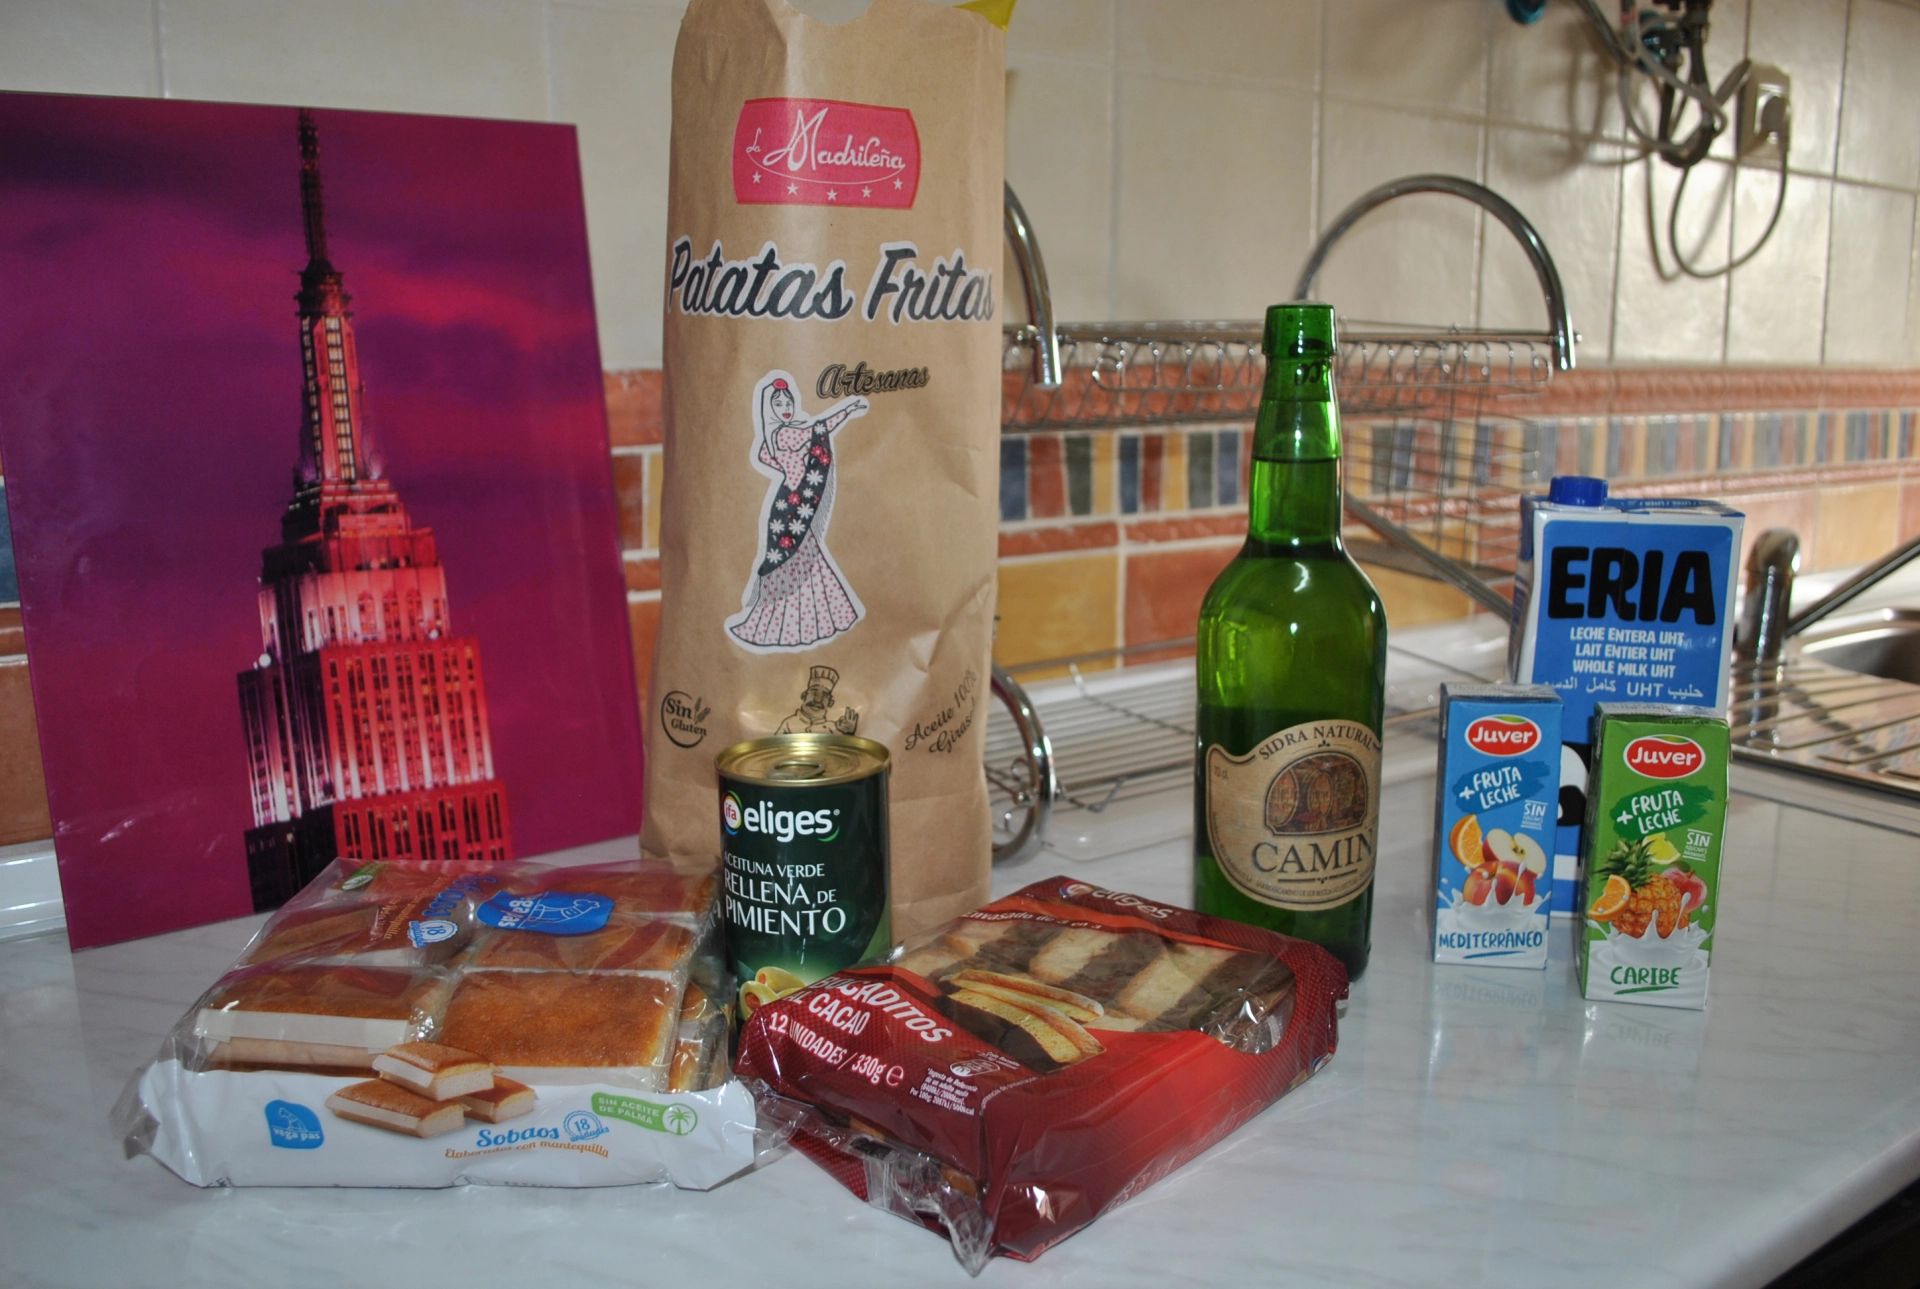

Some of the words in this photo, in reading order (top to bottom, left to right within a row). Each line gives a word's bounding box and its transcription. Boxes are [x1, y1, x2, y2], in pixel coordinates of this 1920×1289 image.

[746, 127, 763, 153] La
[763, 107, 906, 171] Madrileña
[668, 238, 855, 319] Patatas
[866, 246, 995, 323] Fritas
[816, 361, 930, 400] Artesanas
[1547, 545, 1716, 626] ERIA
[1570, 627, 1605, 641] LECHE
[1608, 627, 1656, 645] ENTERA
[1659, 631, 1686, 645] UHT
[1575, 643, 1603, 657] LAIT
[1605, 645, 1648, 660] ENTIER
[1650, 648, 1676, 662] UHT
[1572, 659, 1615, 674] WHOLE
[1617, 662, 1648, 677] MILK
[1650, 665, 1676, 679] UHT
[1586, 677, 1617, 693] كامل
[1626, 681, 1664, 697] UHT
[1668, 684, 1704, 700] حليب
[665, 697, 693, 720] Sin
[904, 704, 955, 752] Aceite
[953, 665, 979, 710] 100%
[671, 717, 709, 738] Gluten
[1472, 726, 1533, 746] Juver
[1258, 729, 1308, 760] SIDRA
[1313, 725, 1374, 750] NATURAL
[1631, 746, 1697, 767] Juver
[1473, 766, 1522, 792] FRUTA
[1479, 784, 1521, 810] LECHE
[1631, 790, 1684, 817] FRUTA
[1523, 801, 1546, 817] SIN
[725, 802, 738, 821] ifa
[743, 800, 834, 843] eliges
[1637, 809, 1682, 835] LECHE
[1686, 831, 1710, 848] SIN
[776, 863, 826, 878] VERDE
[725, 868, 811, 905] RELLENA
[816, 889, 837, 904] DE
[1091, 889, 1174, 919] eliges
[725, 894, 846, 936] PIMIENTO
[962, 910, 1034, 921] Envasado
[426, 925, 447, 936] 18
[1438, 928, 1543, 950] MEDITERRÁNEO
[1610, 965, 1681, 986] CARIBE
[808, 975, 953, 1043] BOCADITOS
[808, 993, 872, 1036] CACAO
[768, 1011, 790, 1034] 12
[789, 1020, 848, 1066] UNIDADES
[851, 1052, 888, 1084] 330g
[598, 1097, 618, 1107] SIN
[620, 1100, 660, 1117] ACEITE
[599, 1104, 615, 1113] DE
[617, 1107, 653, 1125] PALMA
[272, 1128, 299, 1141] vega
[300, 1132, 321, 1143] pas
[570, 1125, 610, 1143] unidades
[574, 1117, 591, 1133] 18
[475, 1125, 560, 1148] Sobaos
[445, 1144, 513, 1159] Elaborados
[515, 1141, 537, 1150] con
[539, 1141, 610, 1159] mantequilla
